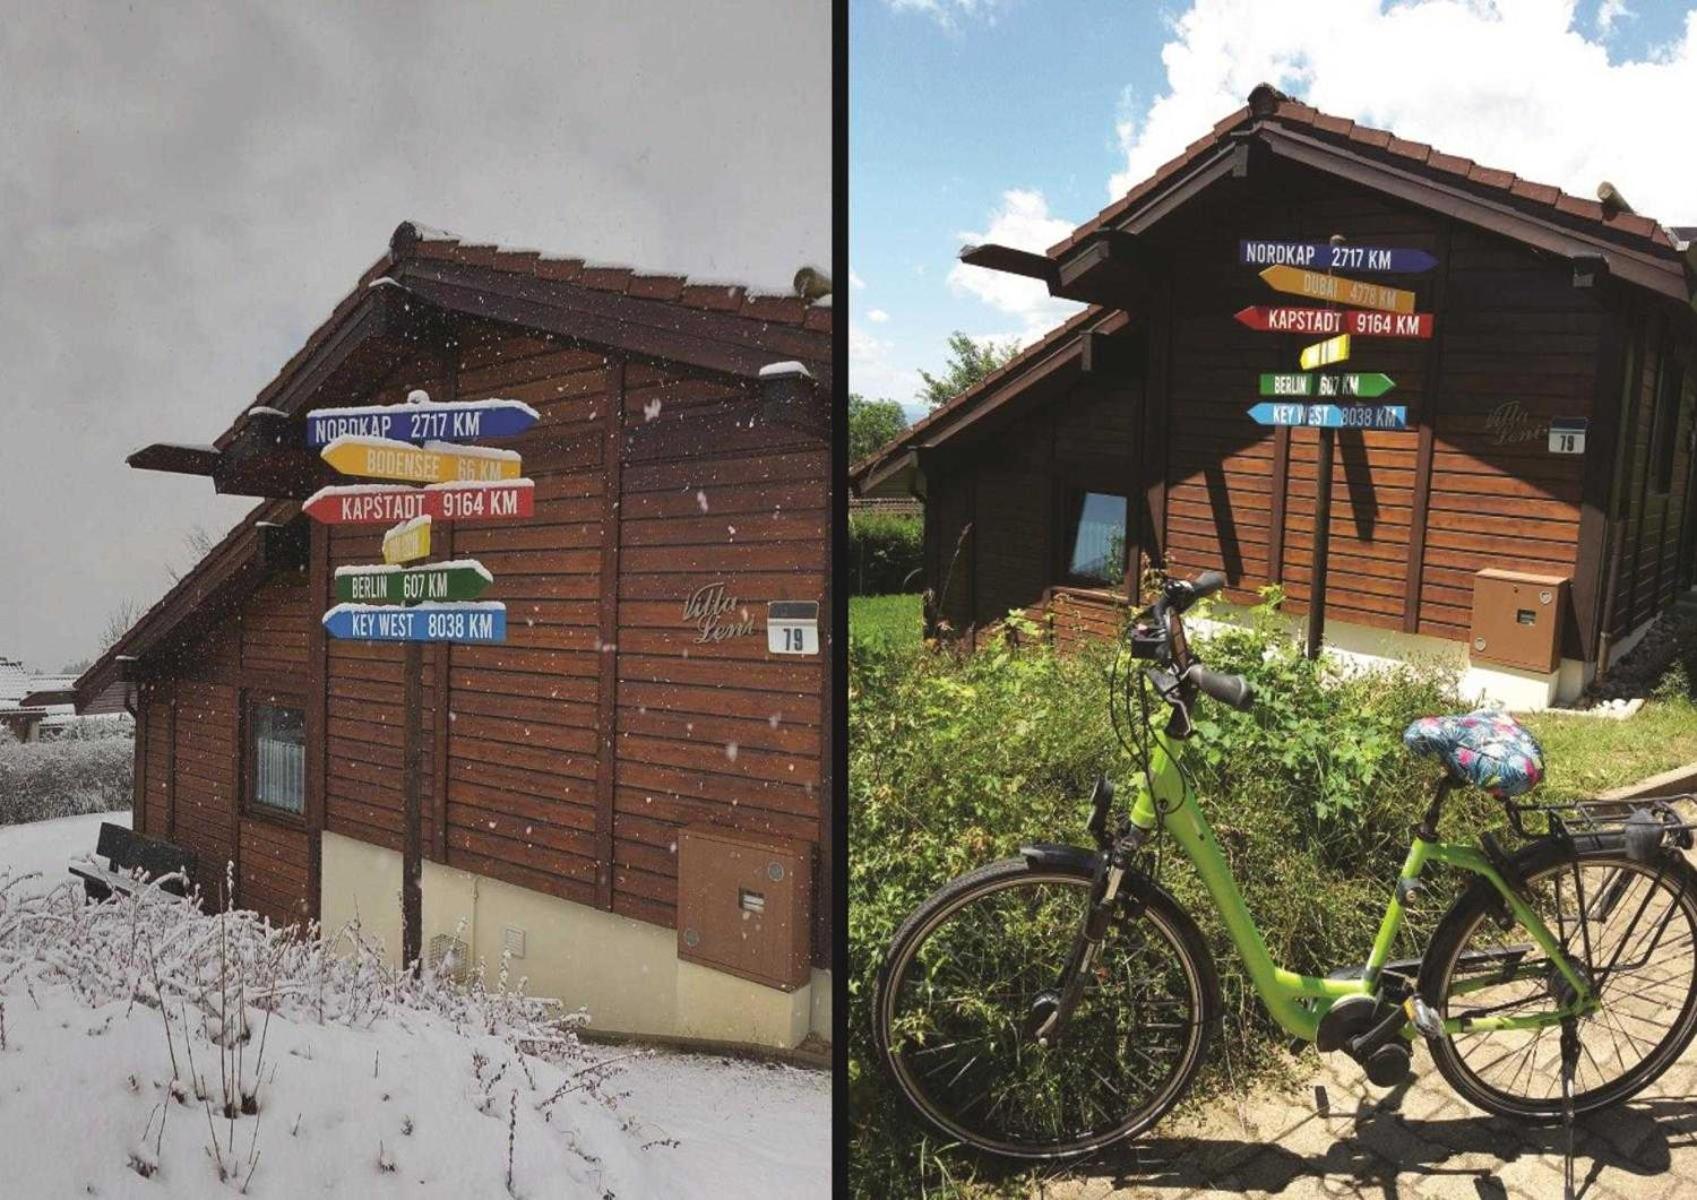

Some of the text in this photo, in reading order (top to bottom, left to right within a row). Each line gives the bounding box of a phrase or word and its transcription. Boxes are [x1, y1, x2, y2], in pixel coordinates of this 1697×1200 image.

[1246, 244, 1392, 270] NORDKAP 2717 KM
[1304, 274, 1338, 298] DUBAI
[1379, 286, 1396, 309] KM
[1269, 310, 1419, 335] KAPSTADT 9164 KM
[1274, 375, 1359, 394] BERLIN 607 KM
[315, 412, 480, 442] NORDKAP 2717 KM
[1273, 405, 1396, 427] KEY WEST 8038 KM
[1560, 435, 1575, 452] 79
[367, 449, 501, 482] BODENSEE 66 KM
[342, 490, 518, 520] KAPSTADT 9164 KM
[352, 572, 448, 599] BERLIN 607 KM
[683, 582, 738, 621] Villa
[352, 613, 493, 639] KEY WEST 8038 KM
[783, 628, 803, 651] 79
